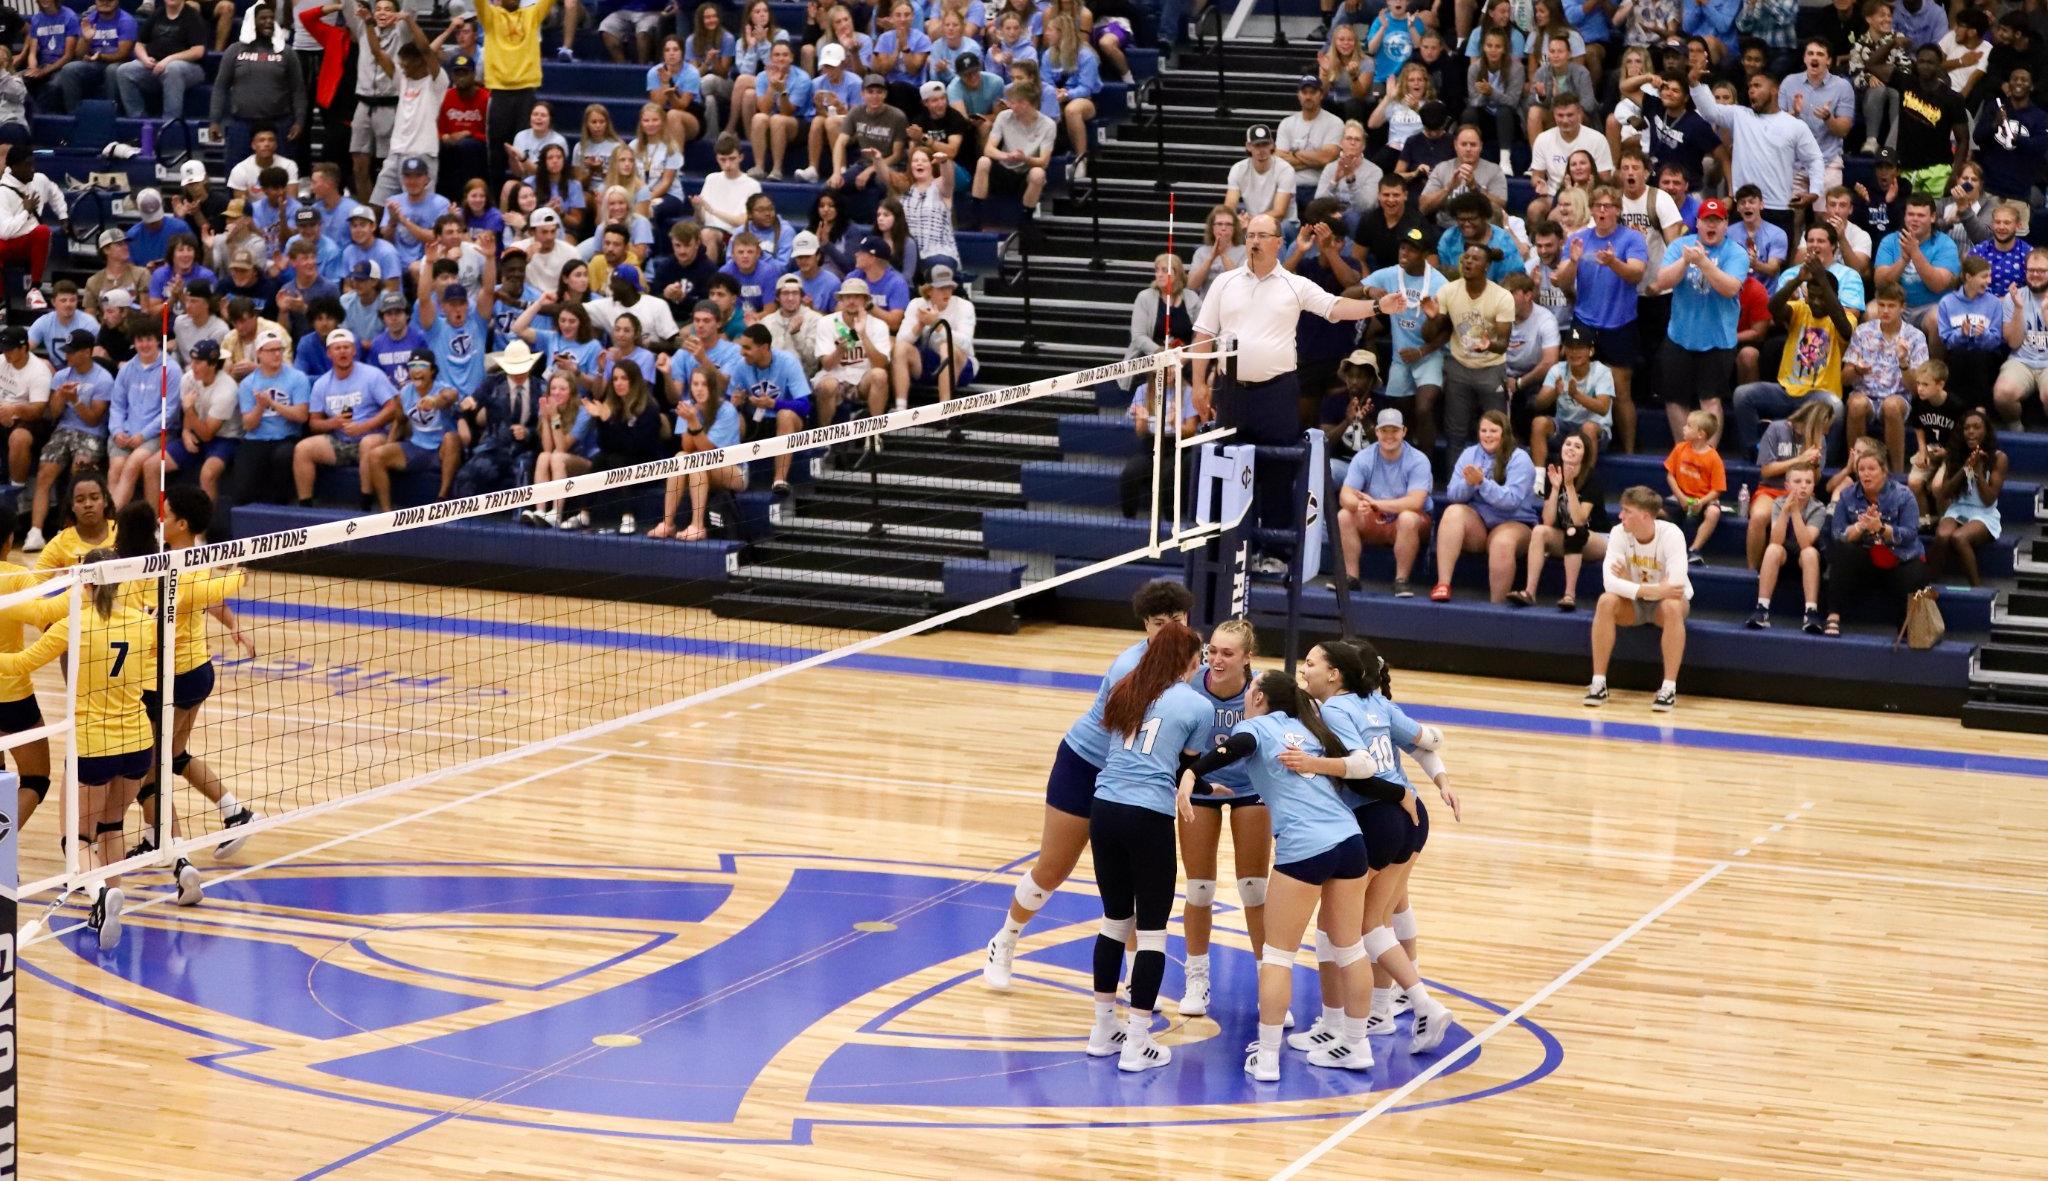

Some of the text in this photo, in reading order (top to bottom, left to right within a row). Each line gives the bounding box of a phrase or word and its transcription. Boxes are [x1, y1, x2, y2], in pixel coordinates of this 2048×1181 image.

[1076, 355, 1155, 385] IOWA CENTRAL TRITONS
[941, 384, 1031, 415] IOWA CENTRAL TRITONS
[786, 415, 889, 449] IOWA CENTRAL TRITONS
[604, 449, 726, 486] IOWA CENTRAL TRITONS
[392, 486, 534, 527] IOWA CENTRAL TRITONS
[142, 529, 308, 574] IOW CENTRAL TRITONS
[109, 641, 130, 678] 7
[1368, 734, 1396, 773] 10
